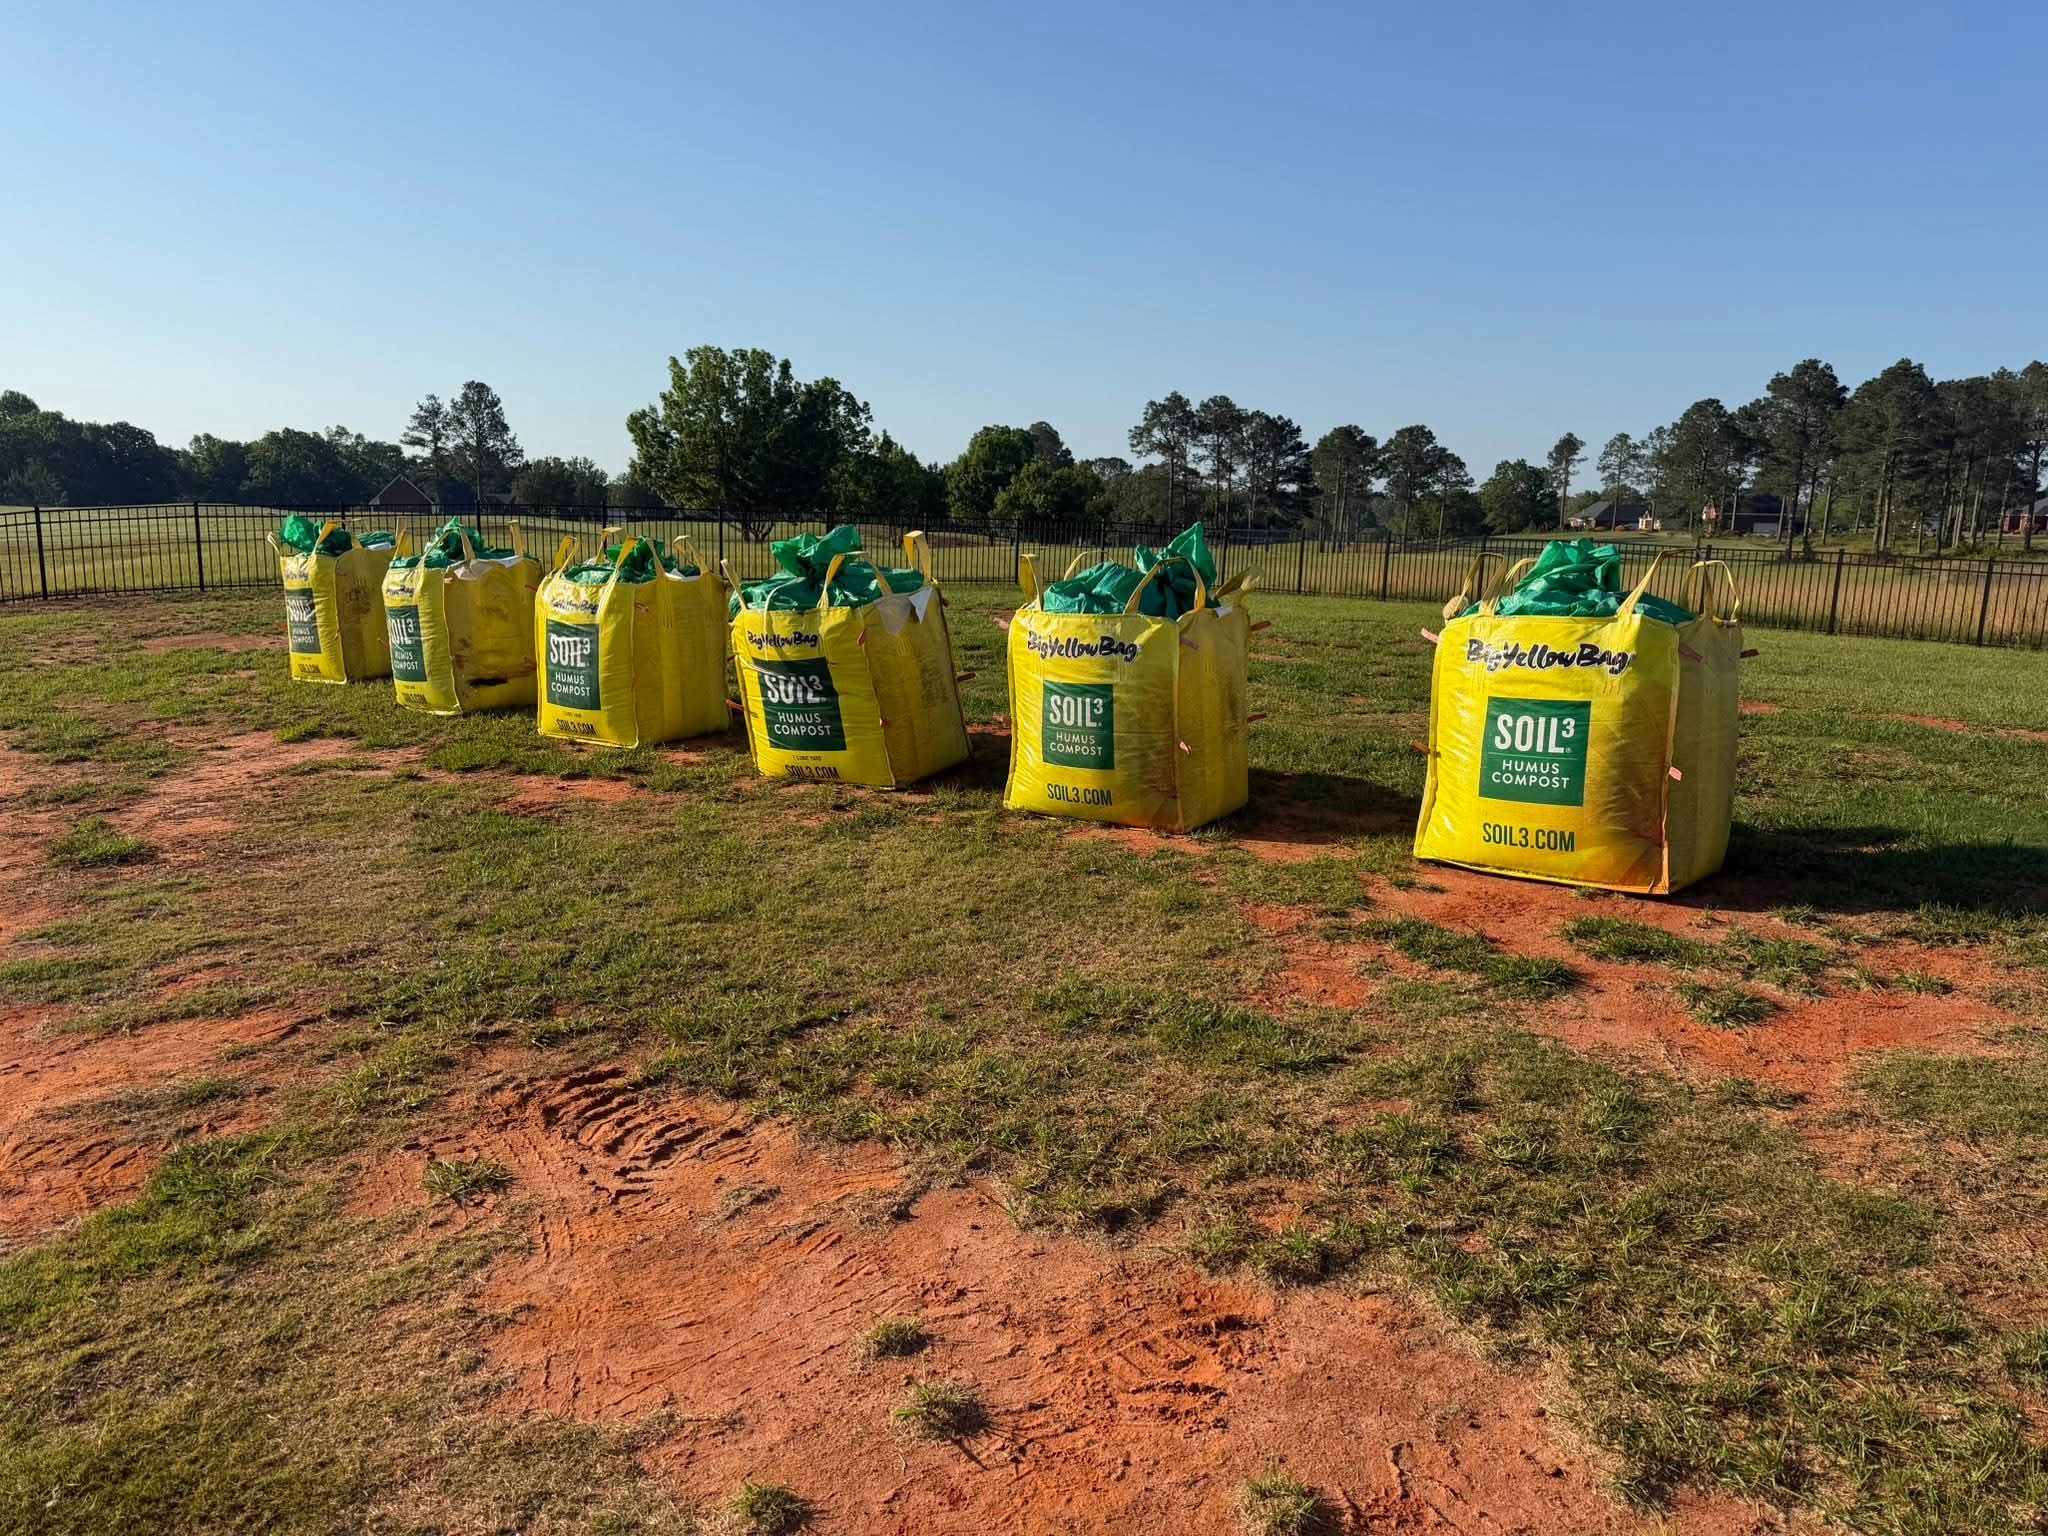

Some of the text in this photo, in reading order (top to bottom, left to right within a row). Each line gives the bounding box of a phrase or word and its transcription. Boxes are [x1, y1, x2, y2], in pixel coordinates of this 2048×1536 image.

[555, 672, 585, 685] HUMUS
[551, 682, 591, 697] COMPOST
[778, 711, 822, 724] HUMUS
[774, 724, 832, 736] COMPOST
[1056, 731, 1096, 744] HUMUS
[1050, 742, 1103, 756] COMPOST
[785, 764, 840, 779] SOIL3.COM
[1502, 759, 1560, 774] HUMUS
[1491, 771, 1570, 789] COMPOST
[1047, 783, 1113, 806] SOIL3.COM
[1482, 822, 1576, 852] SOIL3.COM
